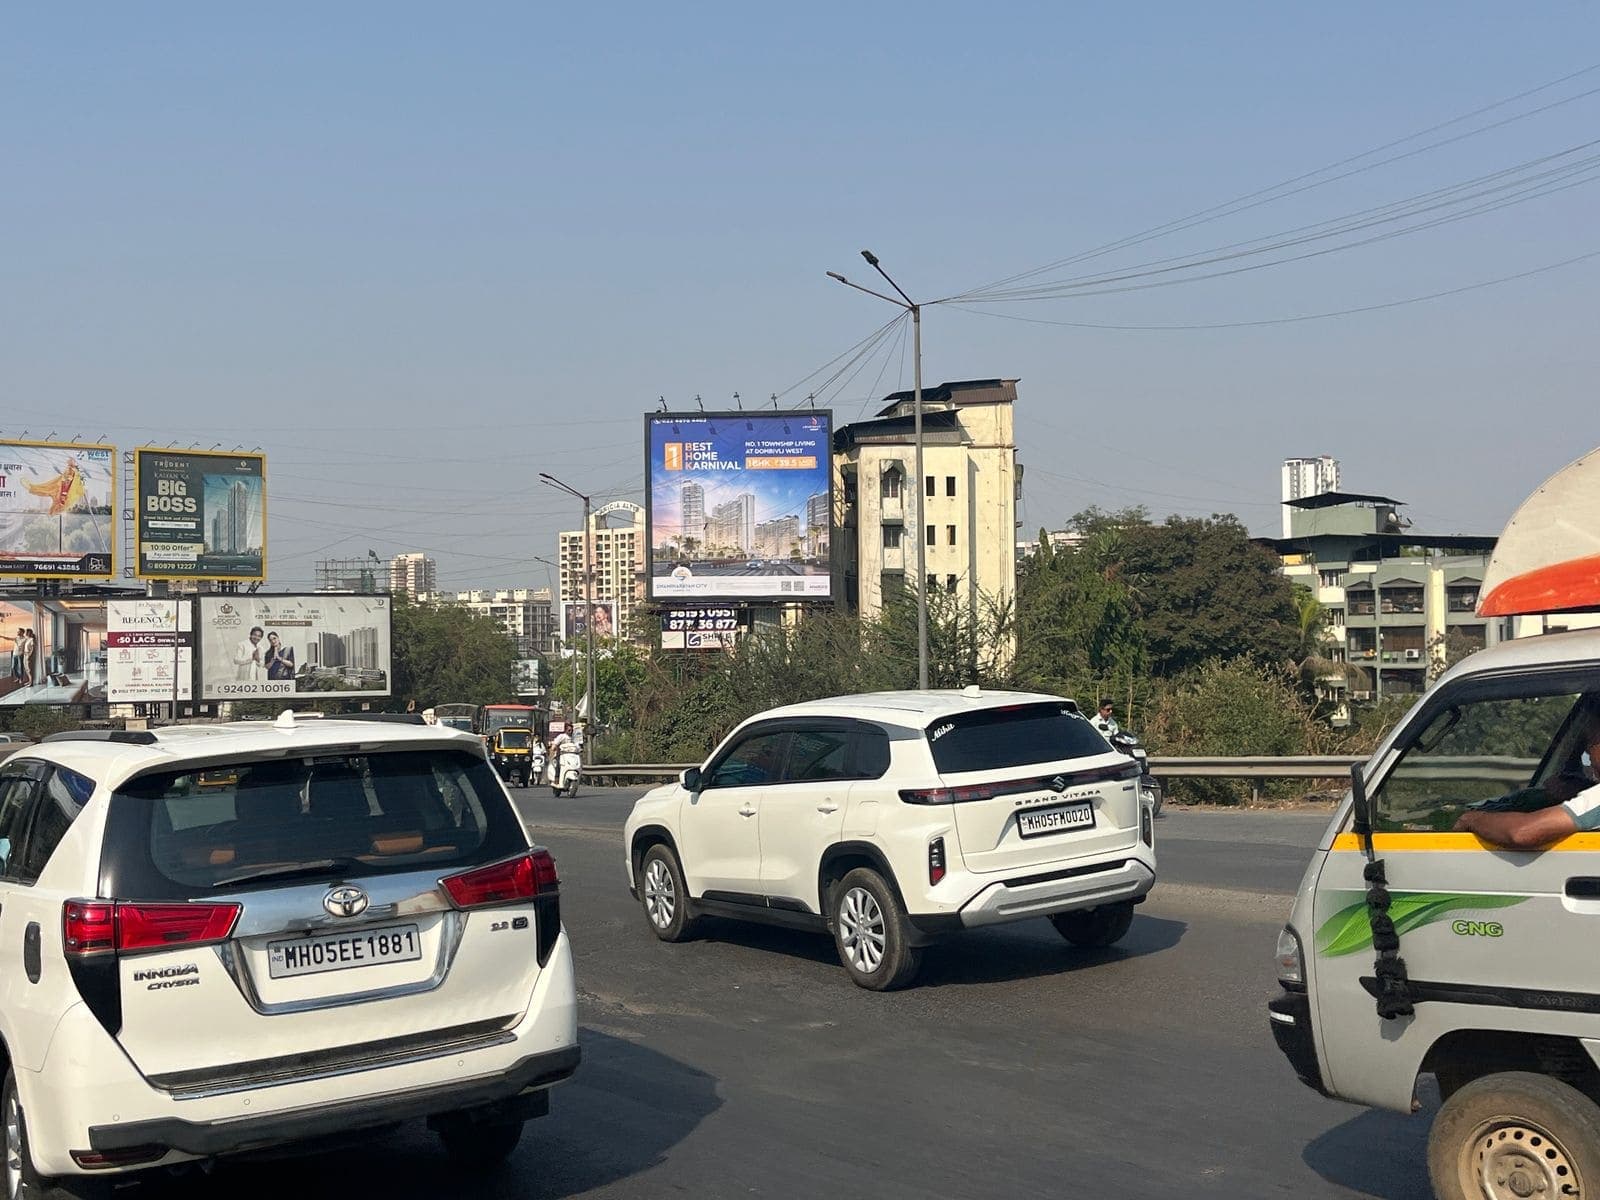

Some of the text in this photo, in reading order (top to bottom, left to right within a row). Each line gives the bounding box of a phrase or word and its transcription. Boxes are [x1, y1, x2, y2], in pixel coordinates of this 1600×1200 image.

[685, 442, 712, 451] BEST
[154, 460, 190, 468] TRIDENT
[685, 452, 718, 460] HOME
[685, 461, 741, 470] KARNIVAL
[158, 479, 187, 496] BIG
[147, 495, 197, 512] BOSS
[223, 684, 291, 692] 92402 10016
[1015, 789, 1101, 806] GRAND VITARA
[1027, 808, 1091, 830] MH05FM0020
[1452, 919, 1504, 937] CNG
[272, 931, 414, 969] IND MH05EE1881
[133, 963, 199, 981] INNOVA
[147, 977, 200, 990] CRYSTA
